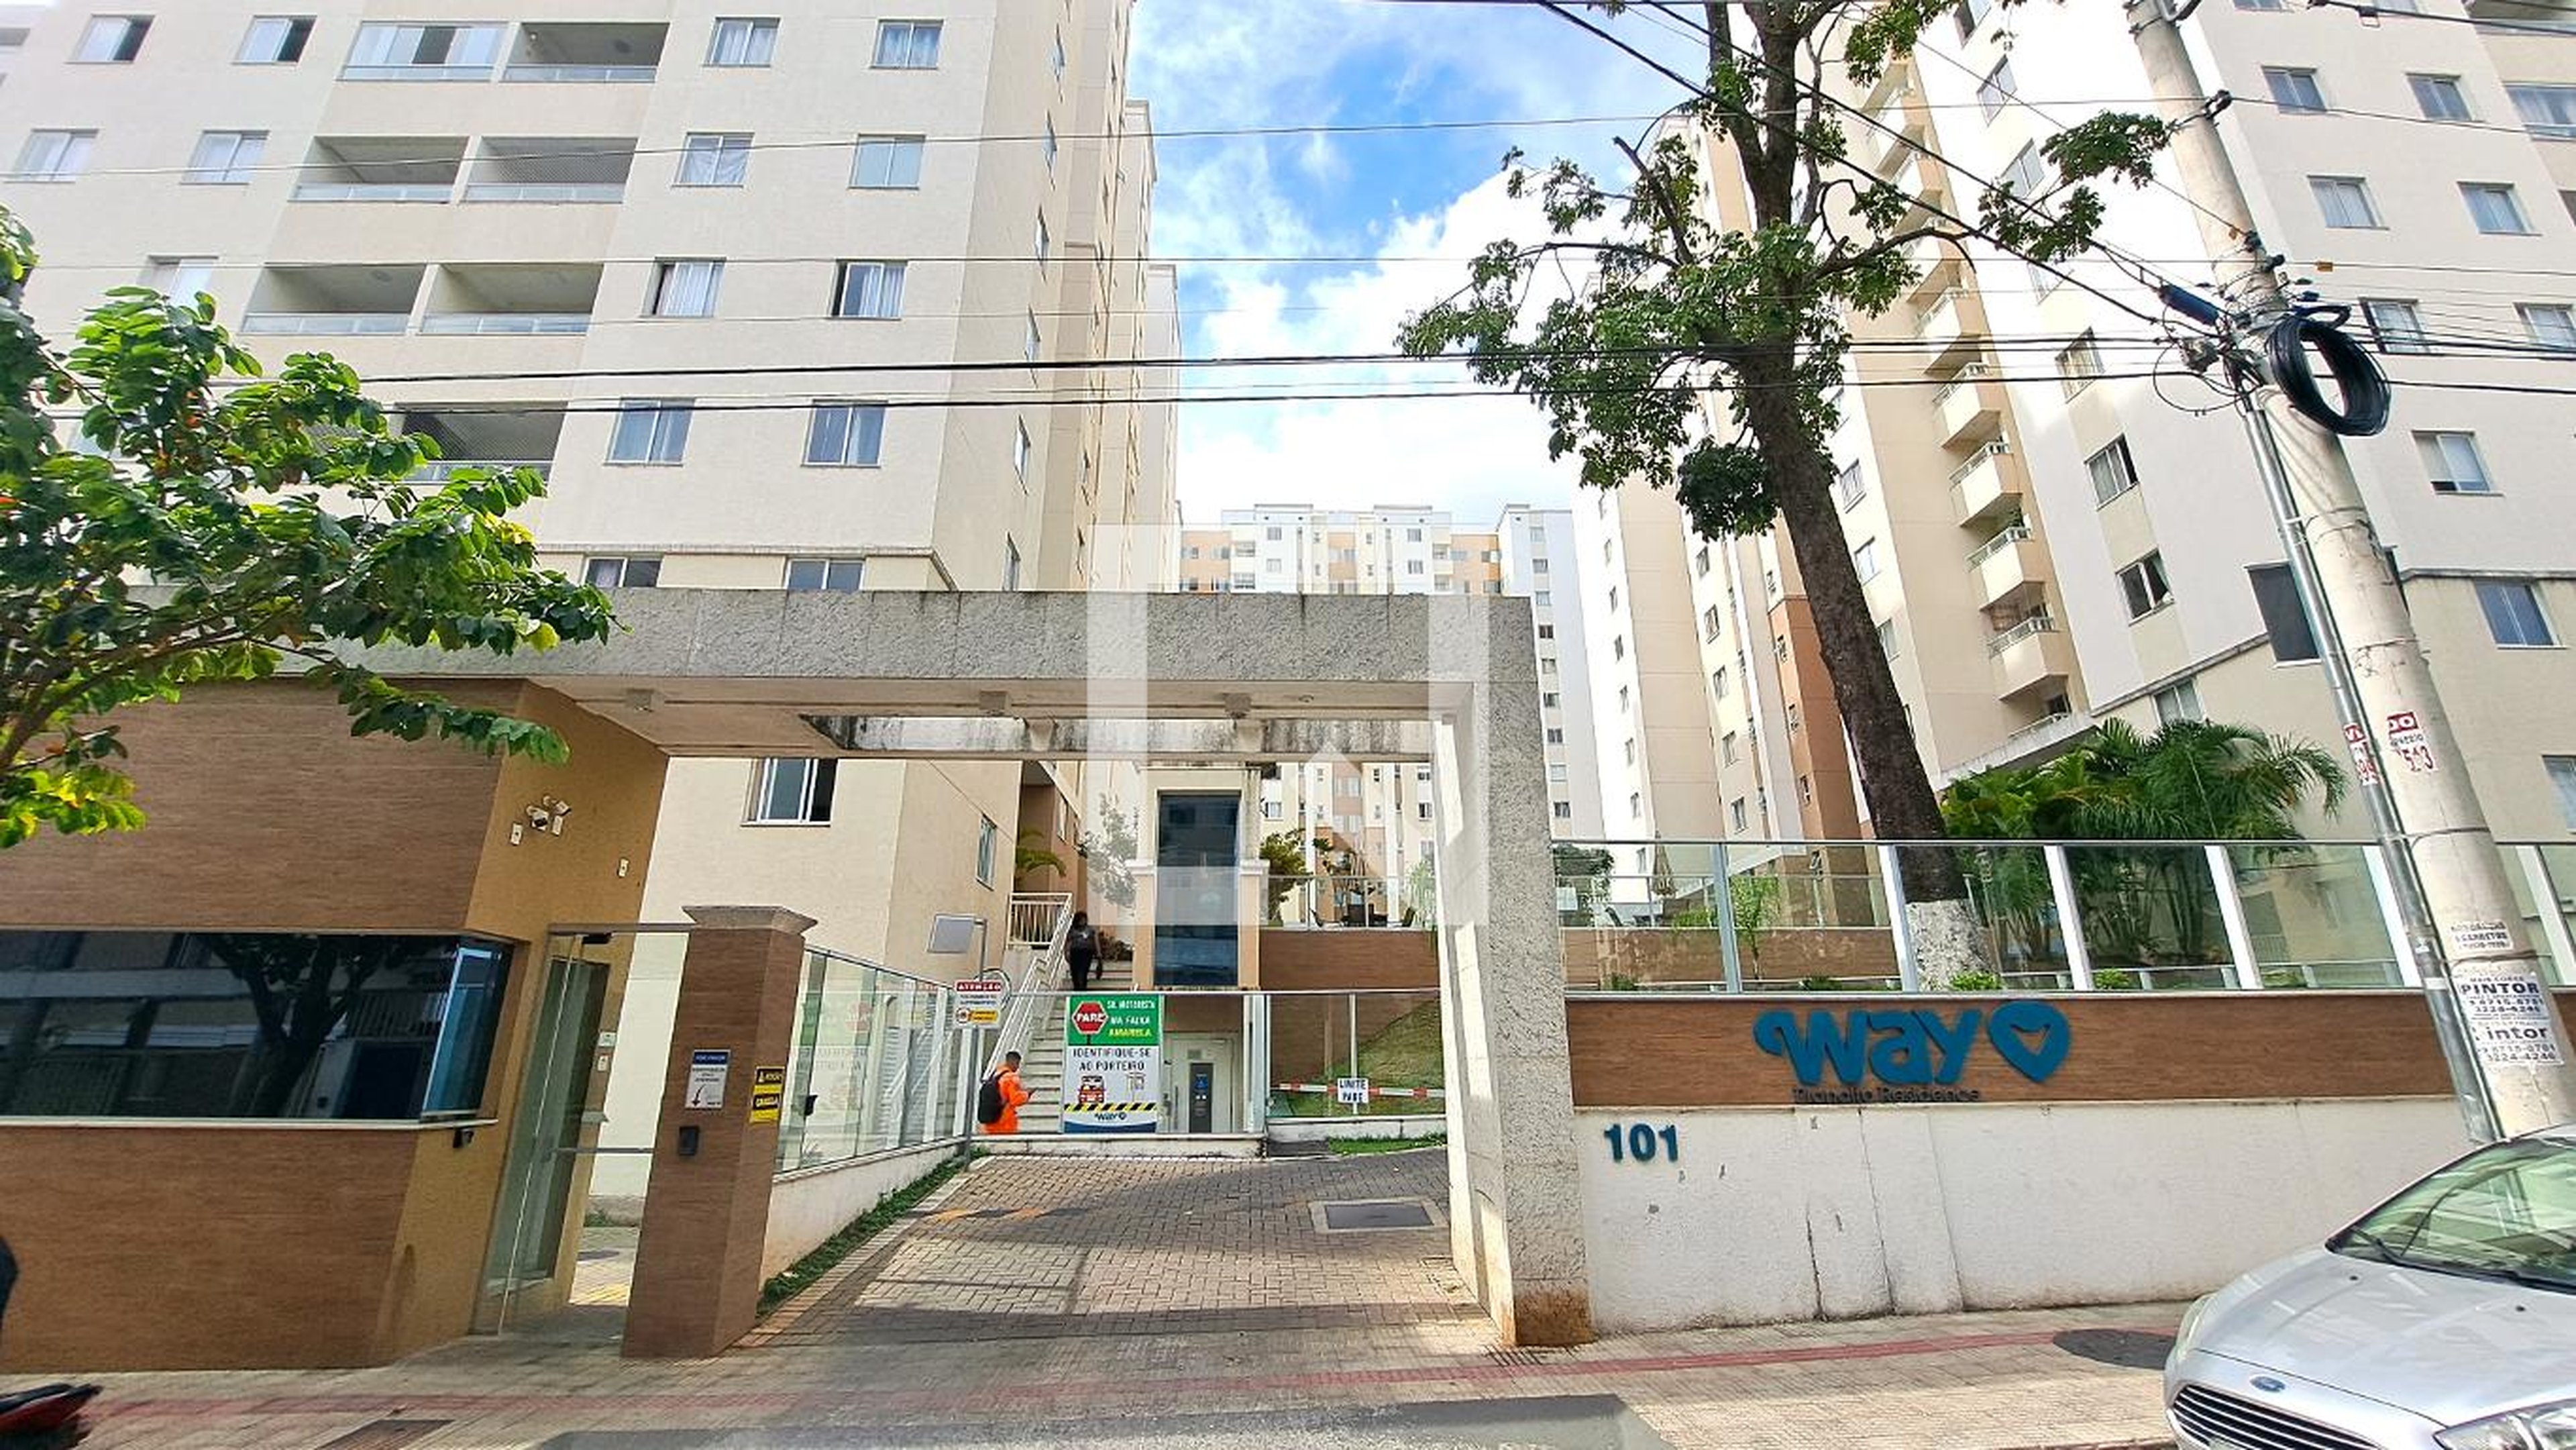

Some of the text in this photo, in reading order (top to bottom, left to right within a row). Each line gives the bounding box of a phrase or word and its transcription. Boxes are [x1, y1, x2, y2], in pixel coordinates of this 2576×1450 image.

[2461, 982, 2539, 994] PINTOR
[1077, 1013, 1106, 1022] PARE
[1125, 1016, 1150, 1025] FAIXA
[1108, 1029, 1152, 1037] AMARELA
[1073, 1048, 1151, 1057] IDENTIFIQUE-SE
[1079, 1061, 1144, 1071] AO PORTEIRO
[1876, 1086, 1980, 1102] Residence
[1603, 1123, 1678, 1162] 101
